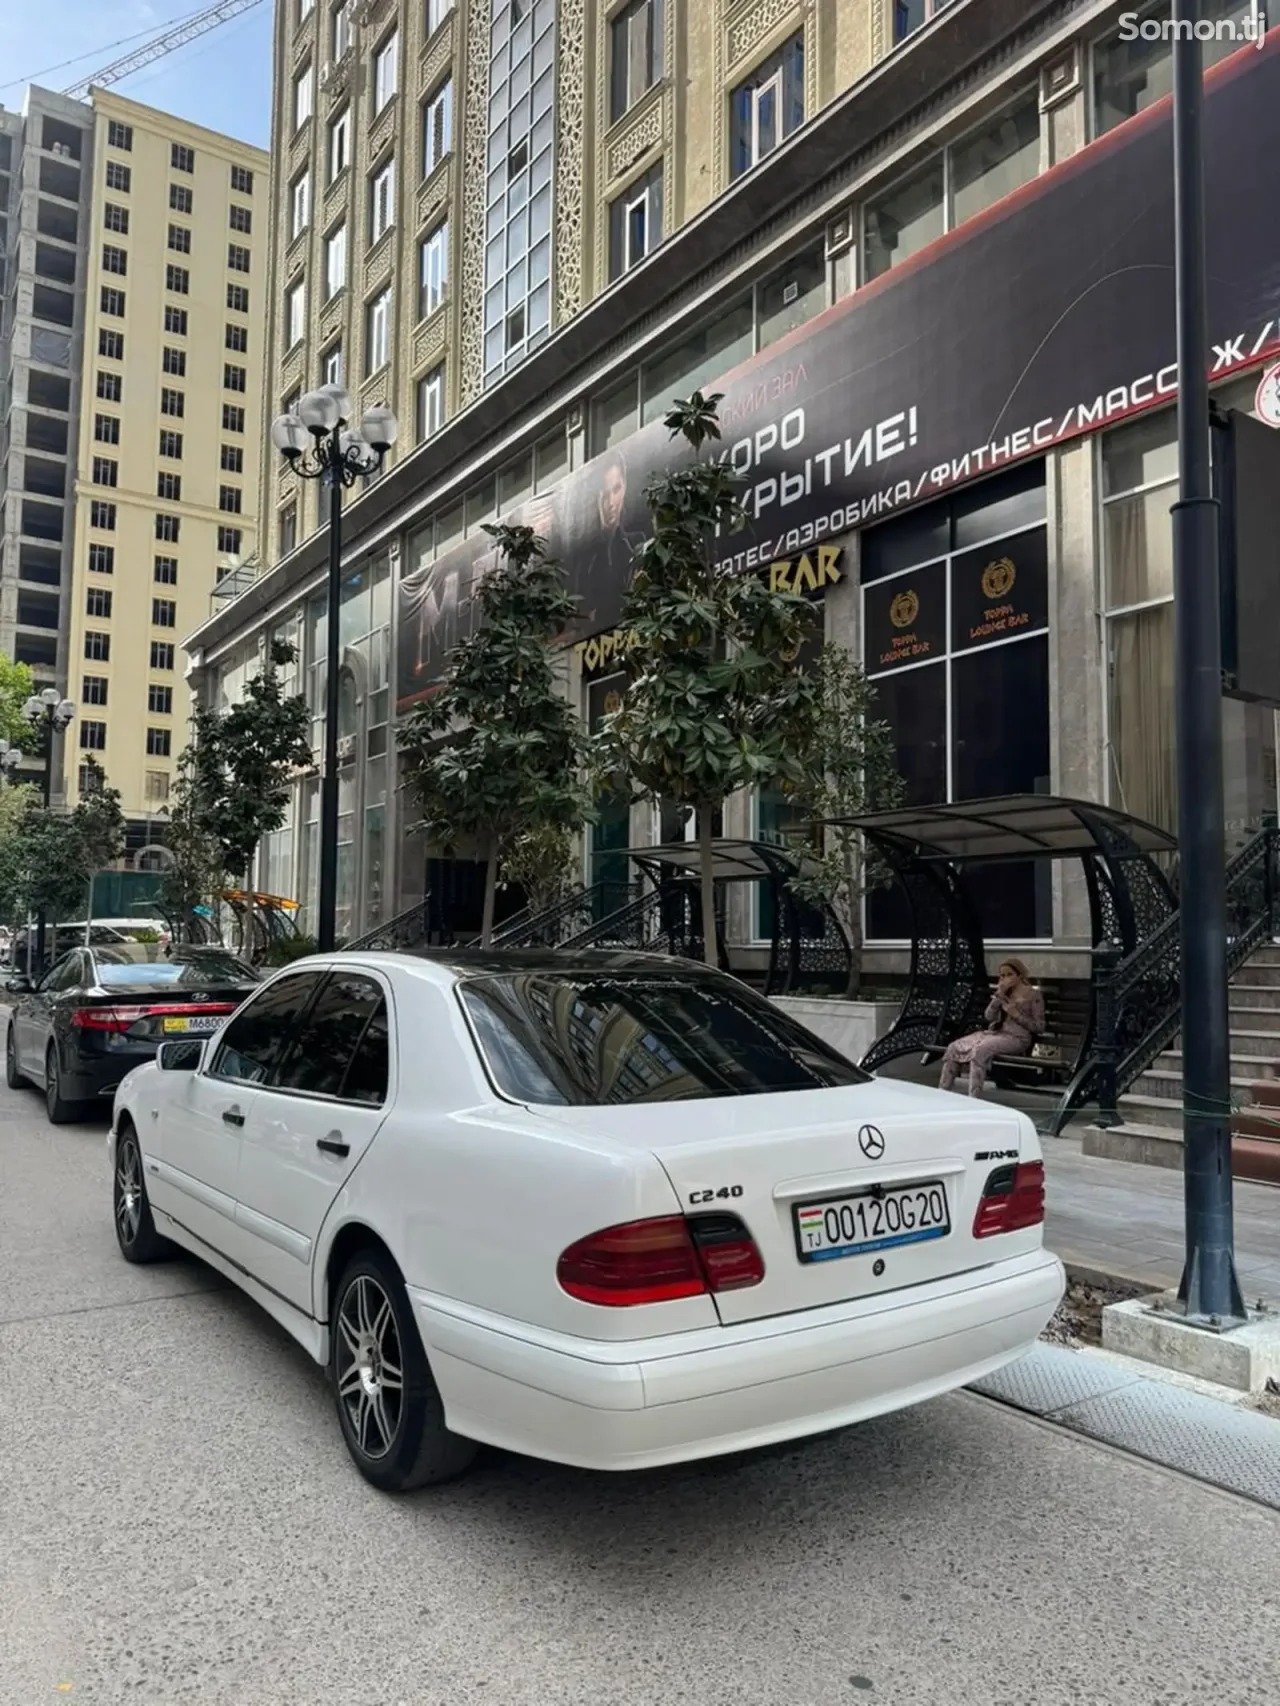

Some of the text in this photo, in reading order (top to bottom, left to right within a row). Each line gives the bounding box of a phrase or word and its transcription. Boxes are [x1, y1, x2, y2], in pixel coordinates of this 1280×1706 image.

[771, 363, 808, 401] ЗАЛ
[709, 407, 805, 476] ОРО
[770, 545, 842, 597] BAR
[1007, 612, 1029, 627] BAR
[989, 1149, 1019, 1160] AMG
[688, 1184, 744, 1205] C240
[807, 1232, 822, 1248] TJ
